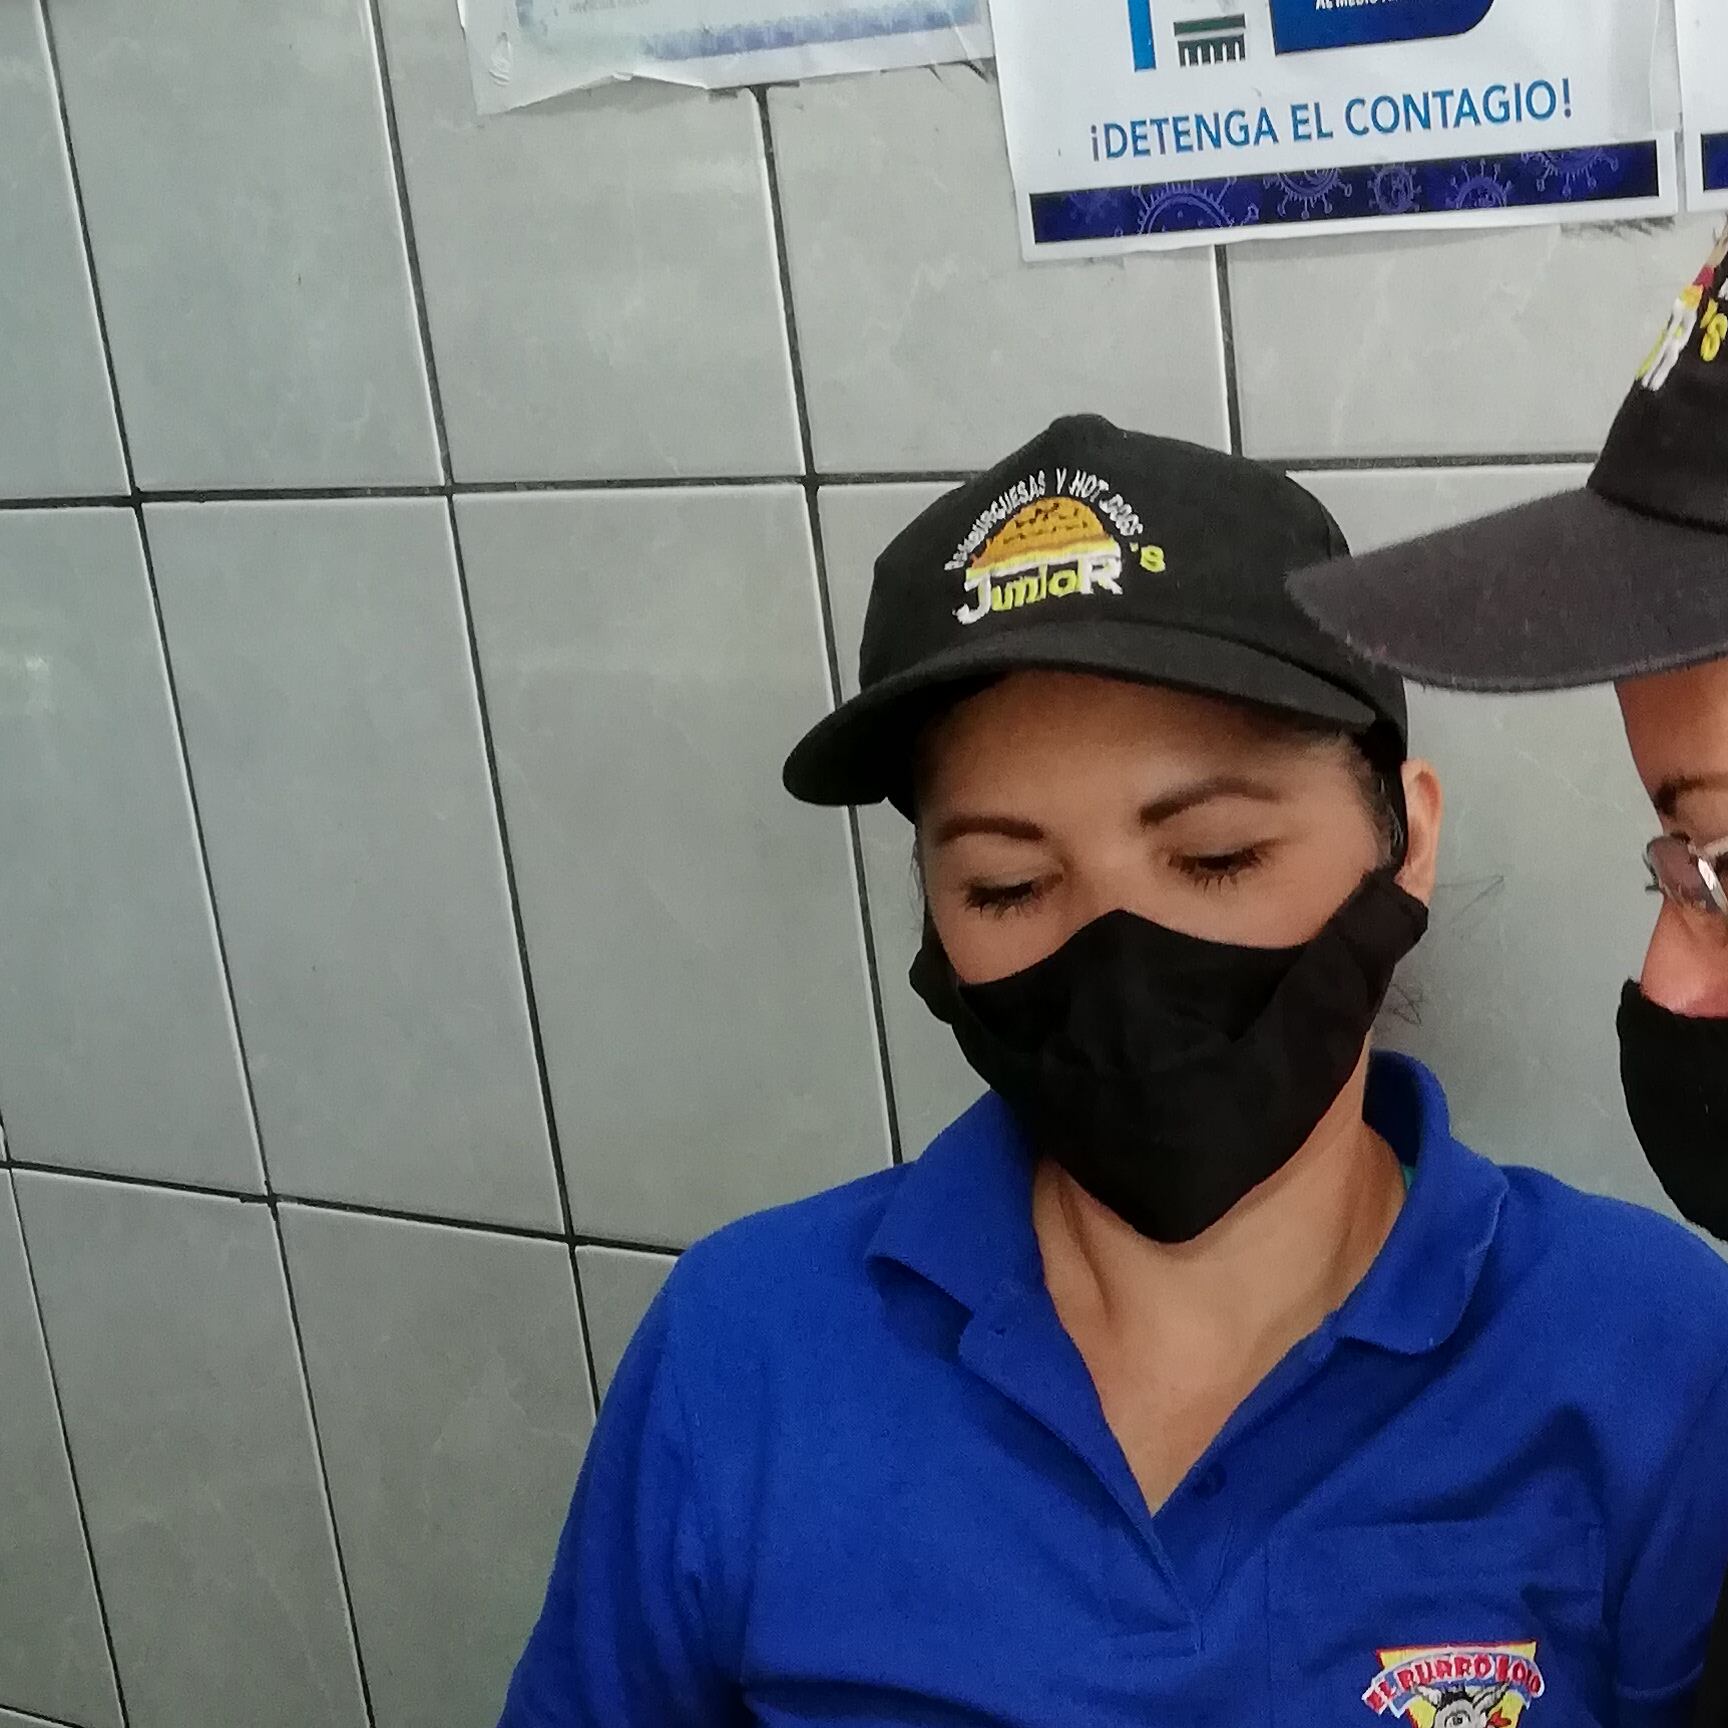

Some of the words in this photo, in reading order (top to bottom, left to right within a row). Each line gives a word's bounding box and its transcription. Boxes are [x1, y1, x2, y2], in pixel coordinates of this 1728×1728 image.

[1090, 102, 1280, 162] ¡DETENGA
[1290, 101, 1334, 143] EL
[1345, 78, 1573, 137] CONTAGIO!
